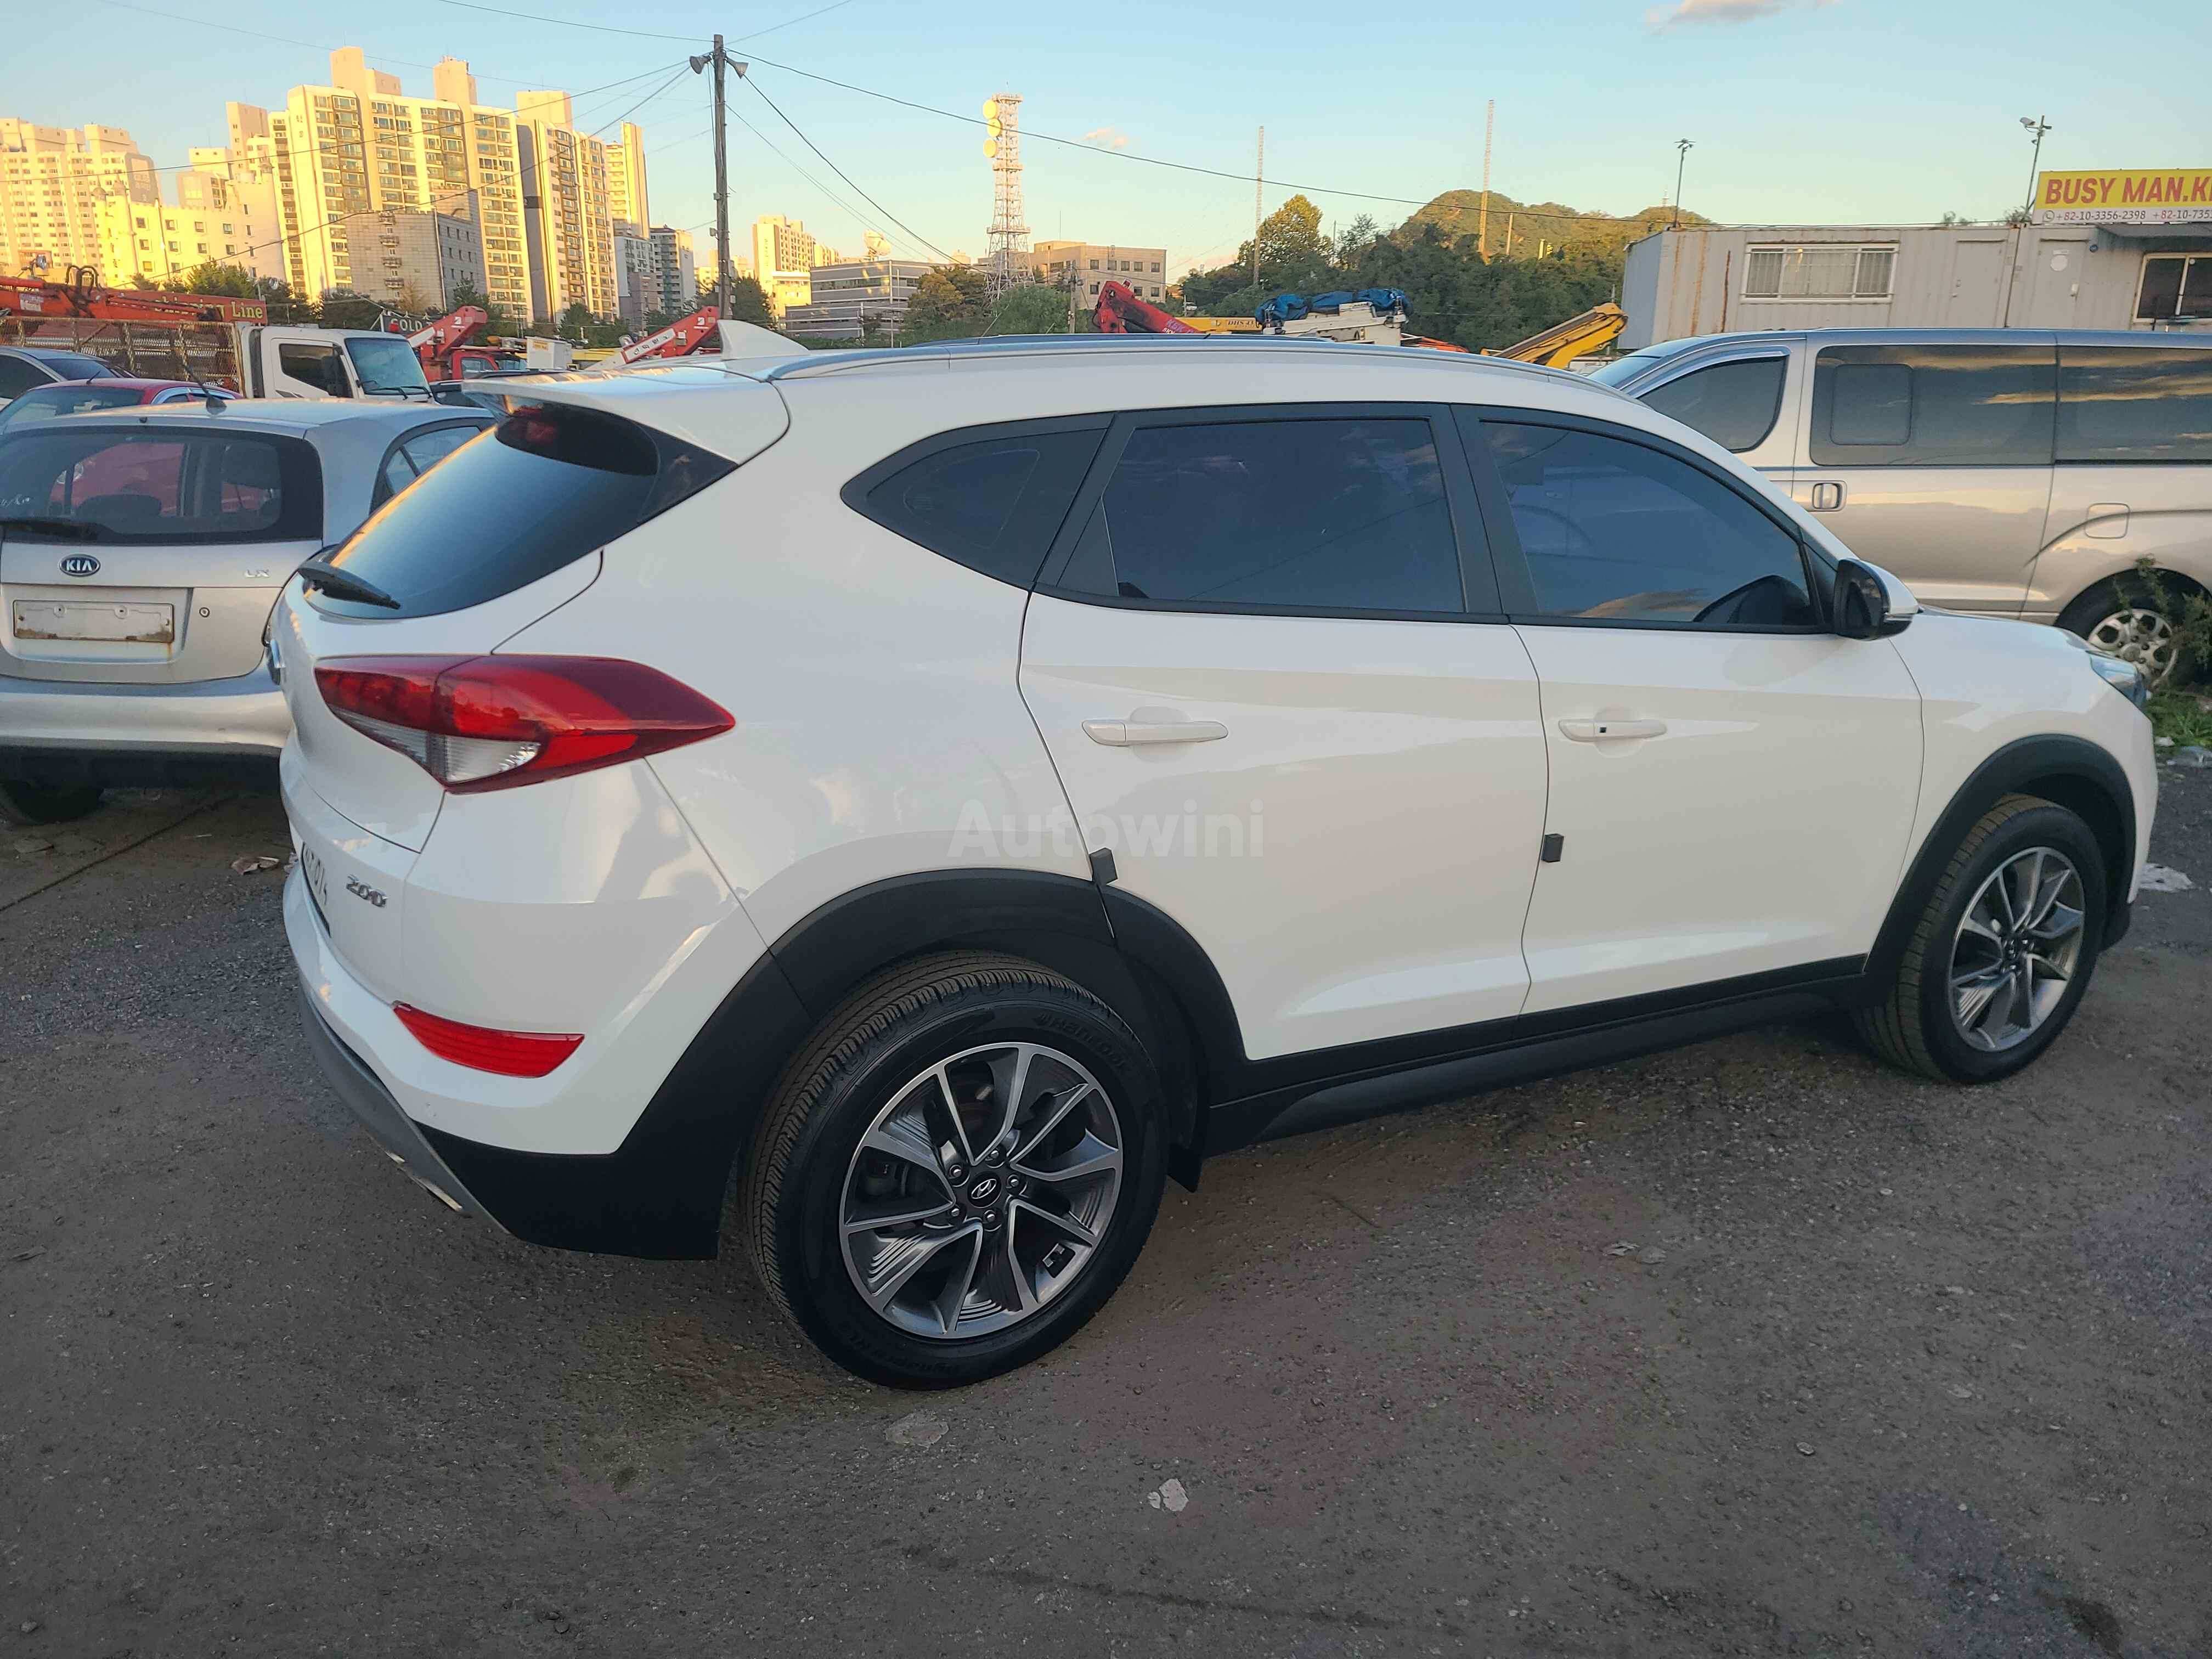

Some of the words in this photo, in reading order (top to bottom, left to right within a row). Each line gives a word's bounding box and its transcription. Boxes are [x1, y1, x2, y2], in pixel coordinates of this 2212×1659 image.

[2045, 177, 2117, 204] BUSY
[2121, 176, 2212, 203] MAN.K
[2056, 210, 2146, 221] +82-10-3356-2398
[2153, 210, 2212, 220] +82-10-735
[231, 301, 263, 319] Line
[66, 560, 92, 571] KIA
[245, 569, 271, 578] LX
